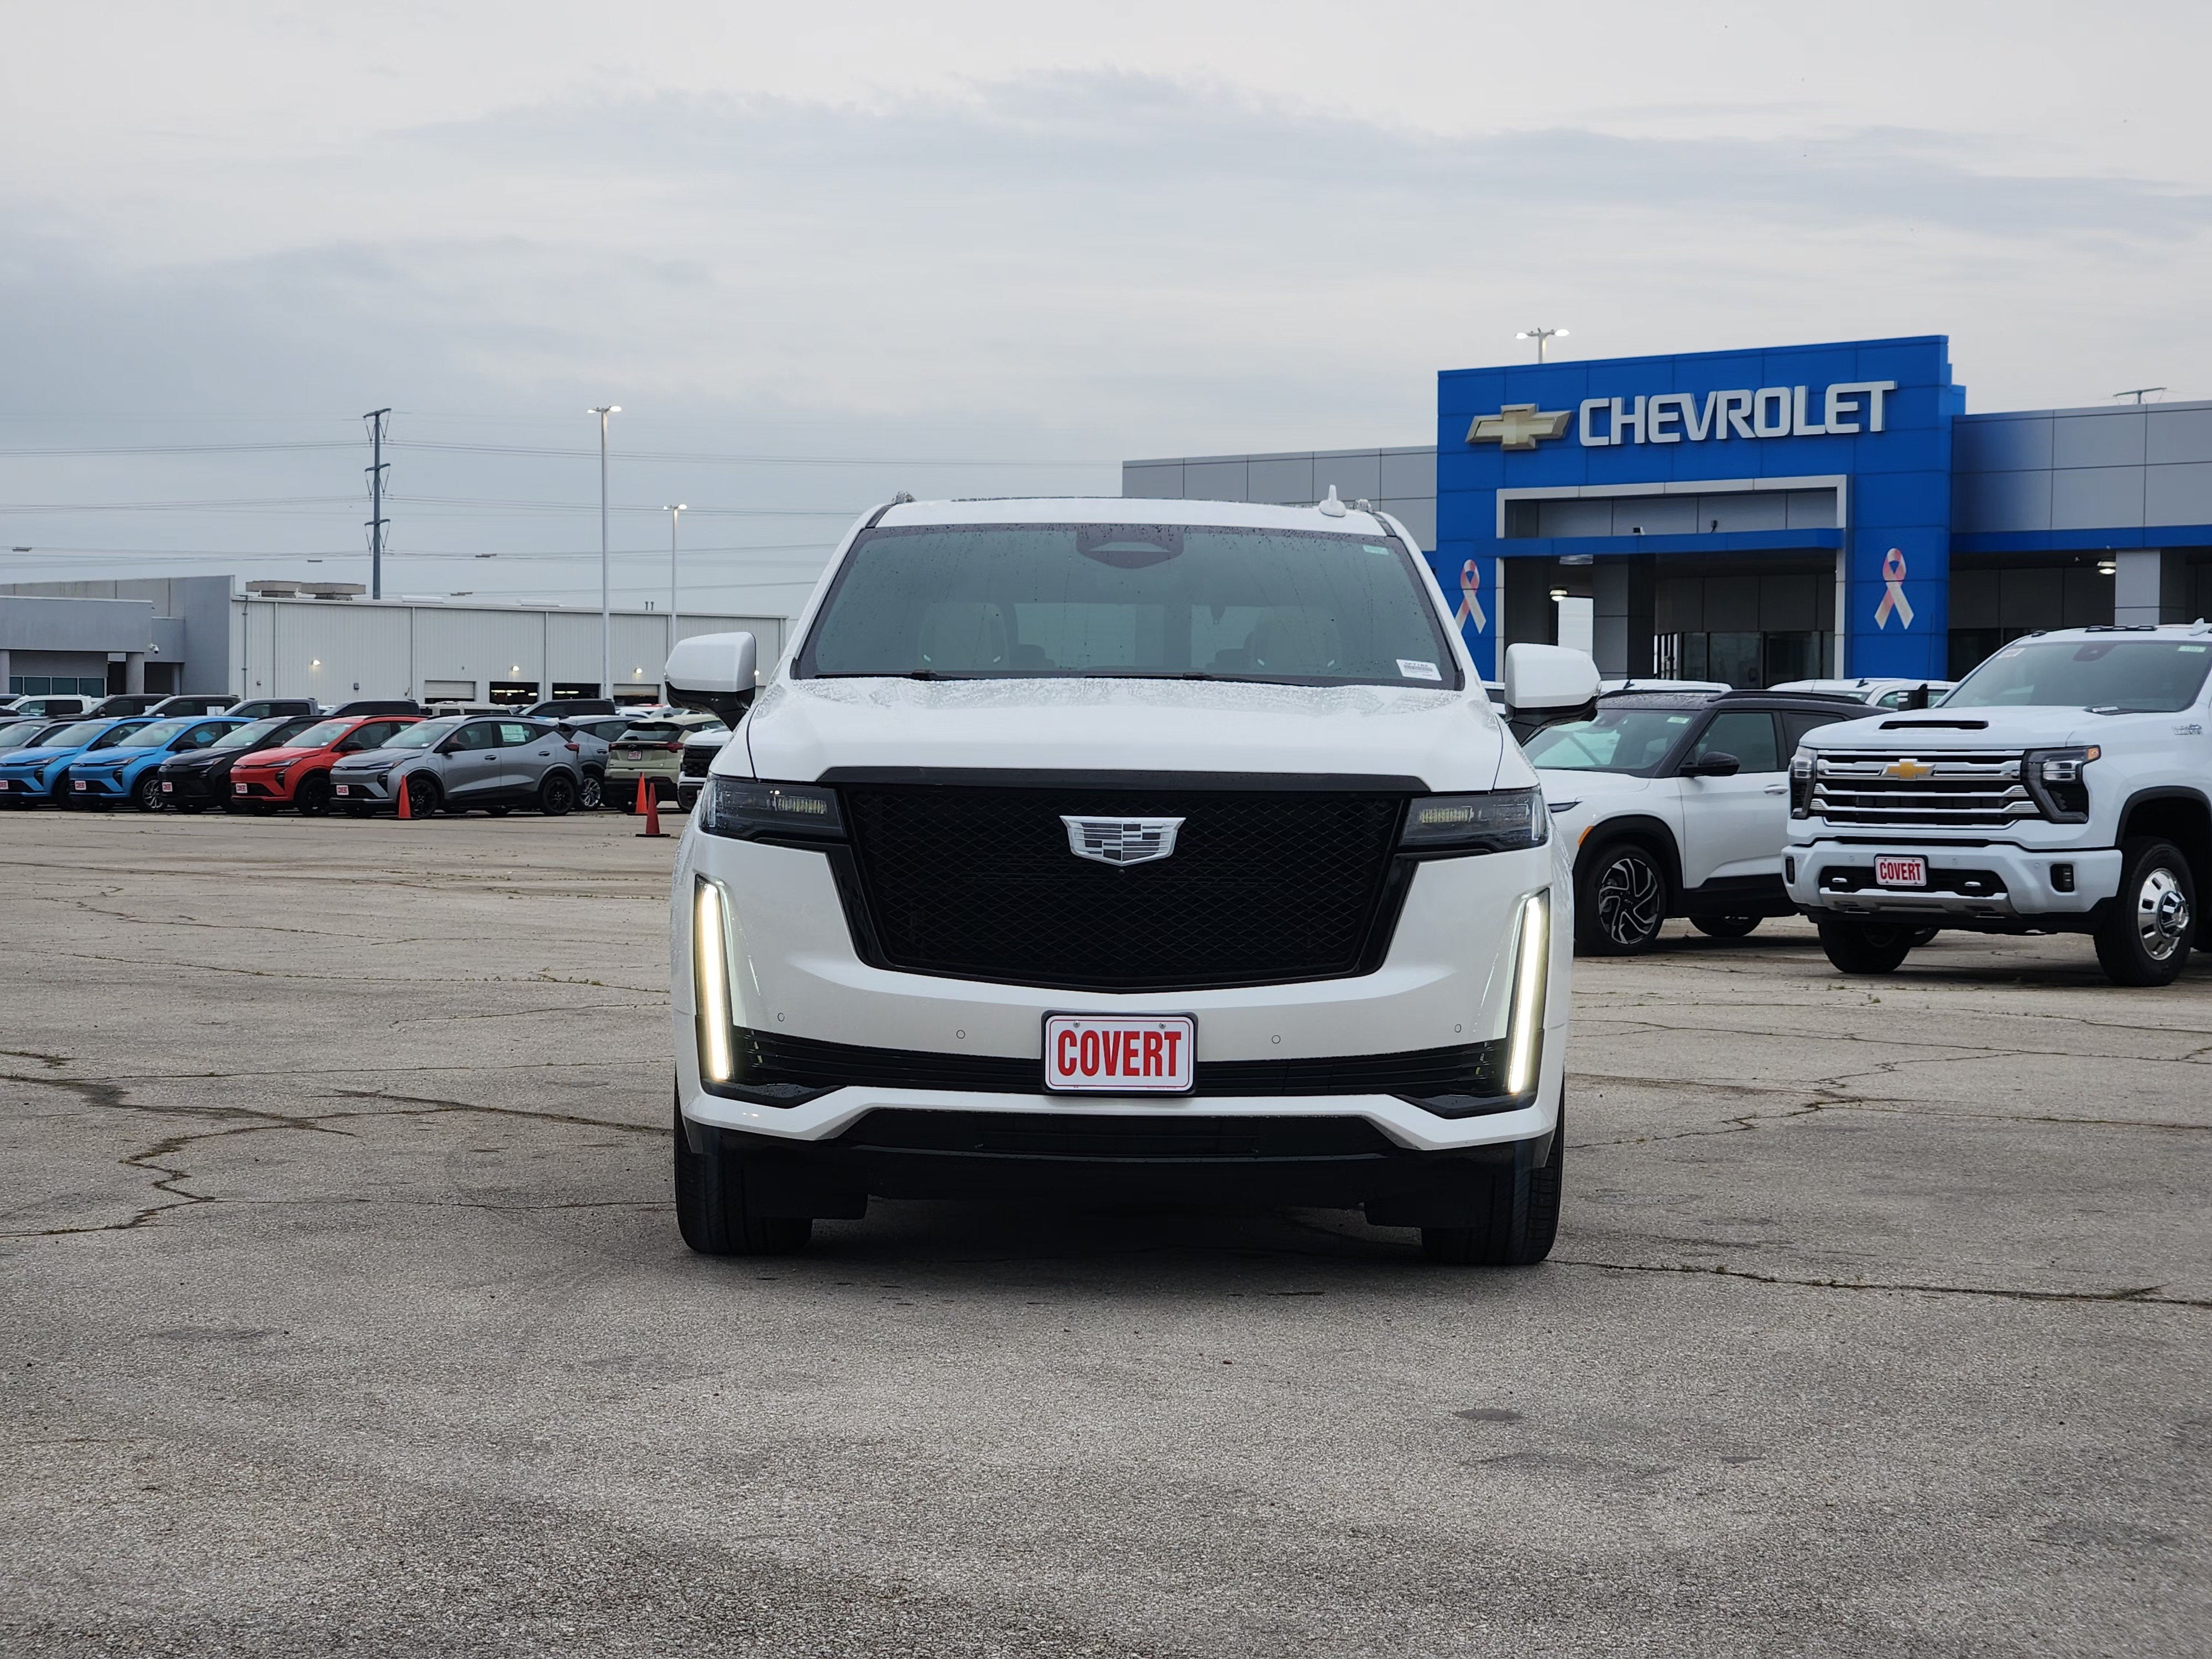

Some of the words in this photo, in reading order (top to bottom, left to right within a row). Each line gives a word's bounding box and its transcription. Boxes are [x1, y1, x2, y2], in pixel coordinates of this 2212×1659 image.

[1579, 380, 1896, 447] CHEVROLET
[1880, 862, 1921, 881] COVERT
[1057, 1029, 1182, 1077] COVERT
